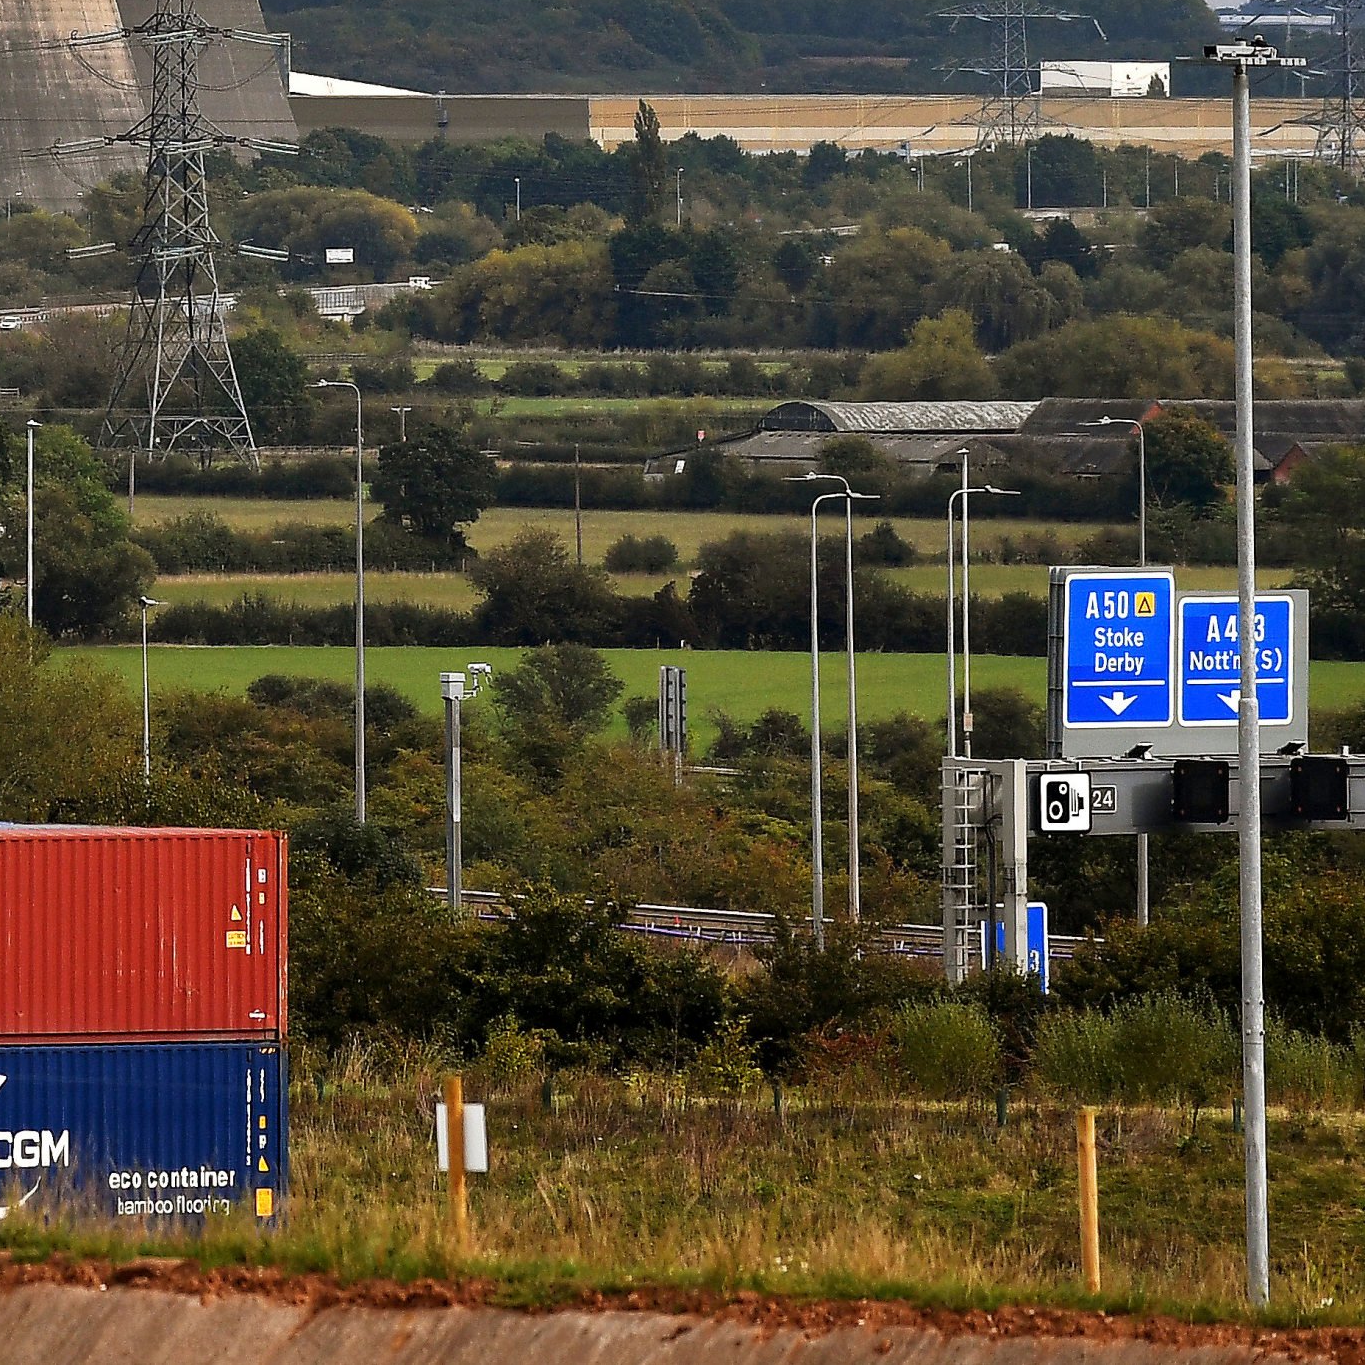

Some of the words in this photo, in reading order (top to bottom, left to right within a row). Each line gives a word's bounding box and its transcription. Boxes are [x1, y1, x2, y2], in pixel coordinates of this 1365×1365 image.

[1086, 591, 1129, 619] A50
[1094, 627, 1144, 647] Stoke
[1207, 615, 1265, 642] A43
[1094, 653, 1145, 675] Derby
[108, 1170, 142, 1190] eco
[147, 1166, 236, 1189] container
[117, 1197, 174, 1216] bamboo
